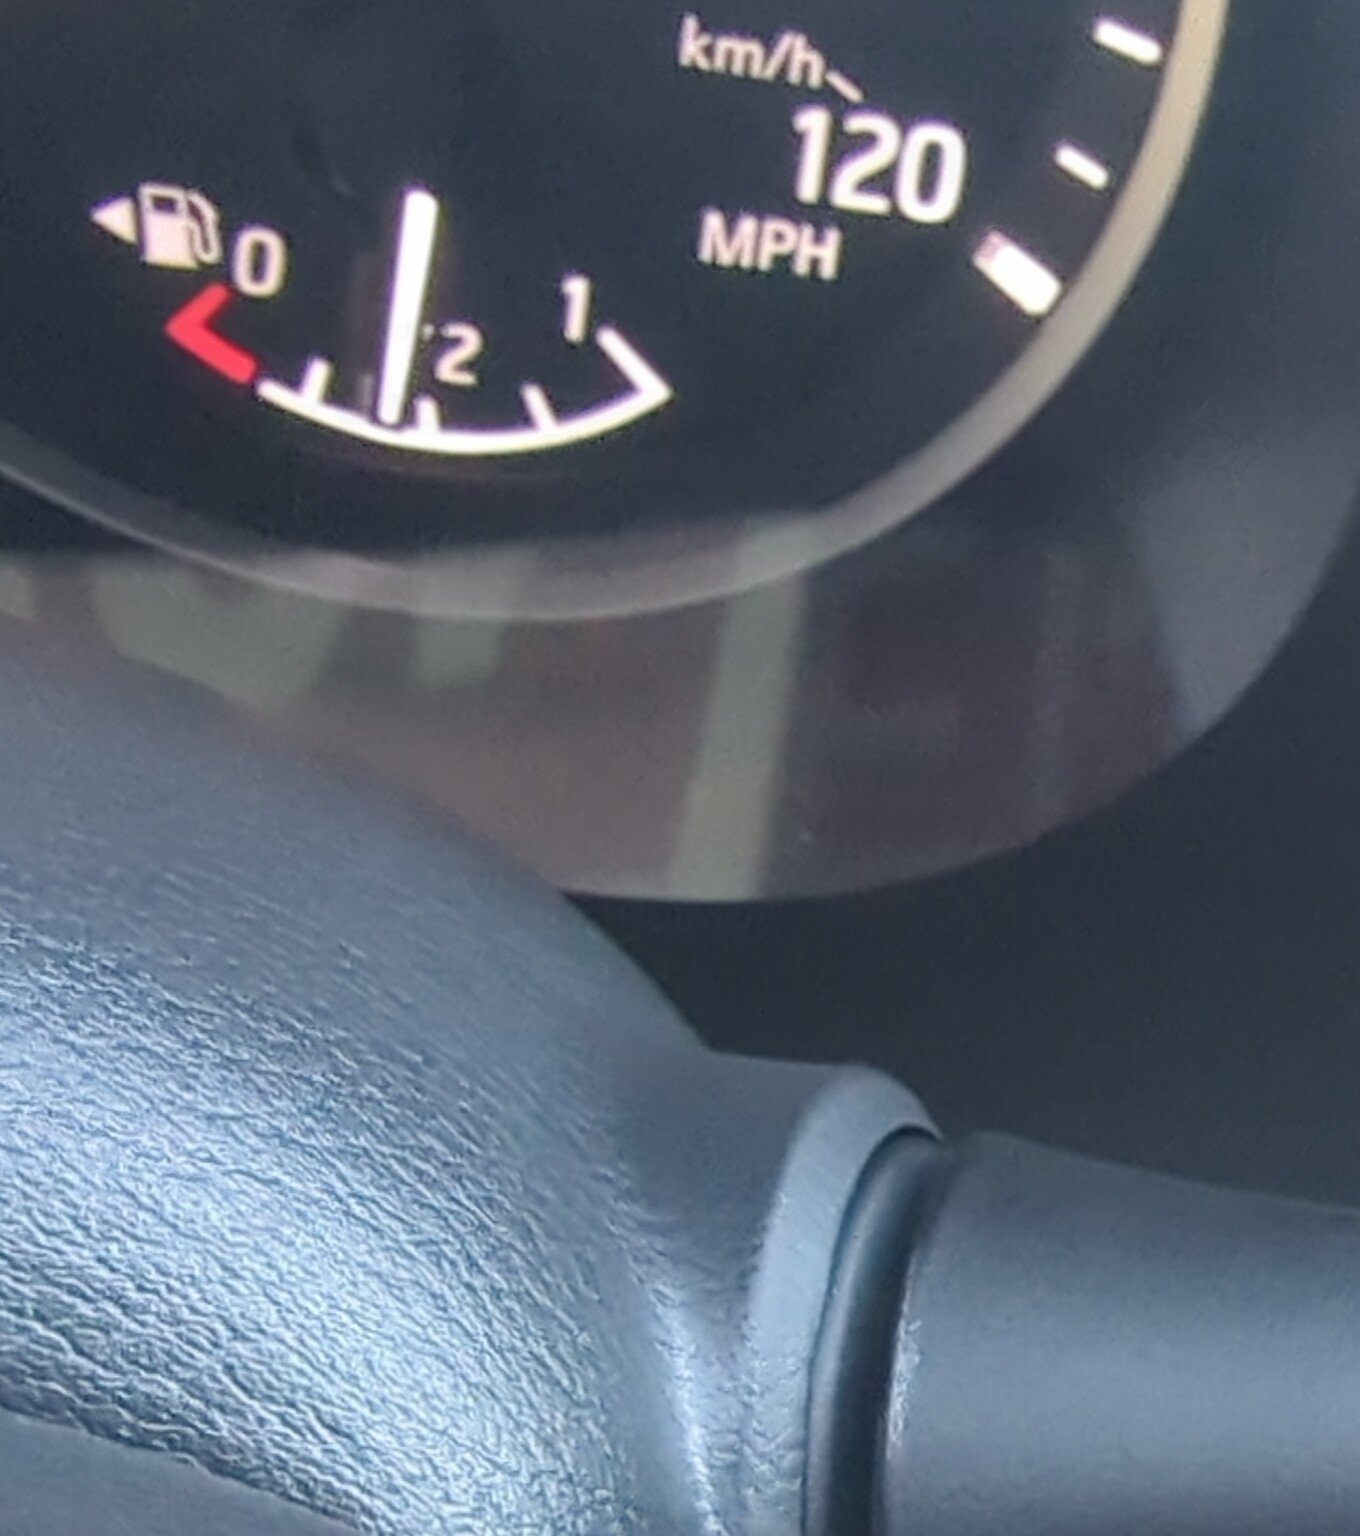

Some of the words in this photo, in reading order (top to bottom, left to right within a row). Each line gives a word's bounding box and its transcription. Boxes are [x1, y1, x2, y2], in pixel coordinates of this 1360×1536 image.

[679, 13, 825, 90] km/h
[792, 104, 967, 224] 120
[234, 228, 286, 298] 0
[698, 209, 843, 281] MPH
[560, 273, 592, 344] 1
